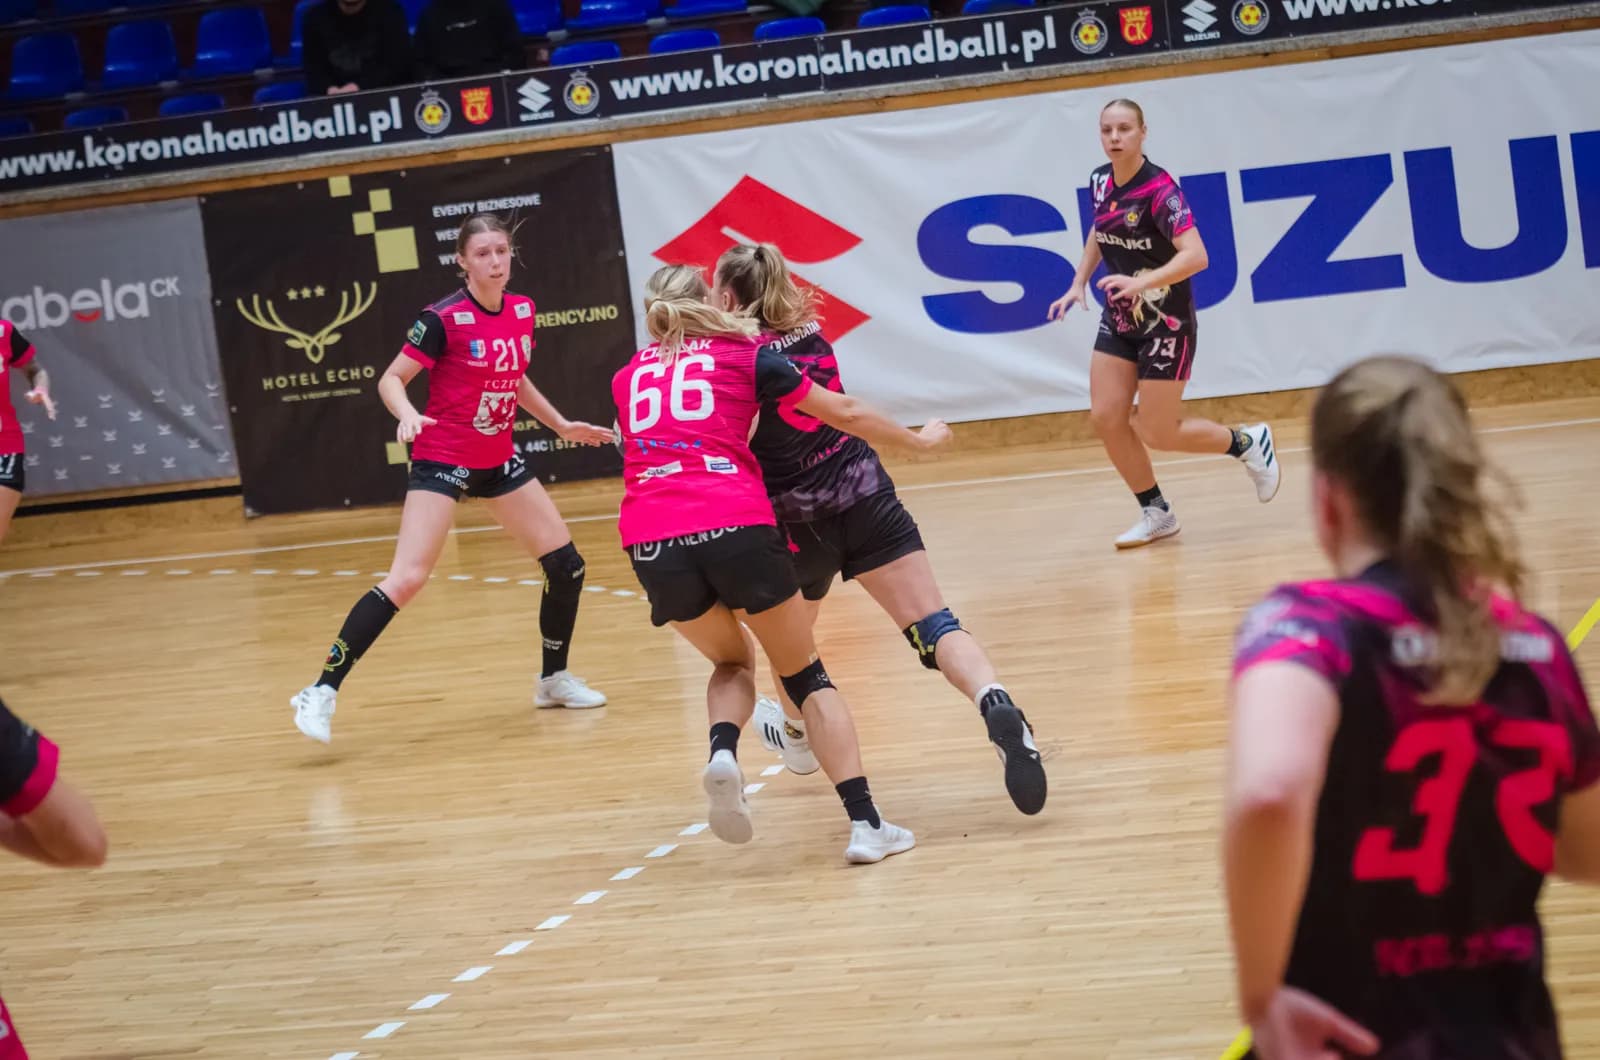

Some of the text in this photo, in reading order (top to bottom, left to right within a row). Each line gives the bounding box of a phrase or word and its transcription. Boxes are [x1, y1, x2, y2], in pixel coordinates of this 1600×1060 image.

[1125, 22, 1147, 42] CK
[1184, 31, 1221, 43] SUZUKI
[610, 16, 1057, 101] www.koronahandball.pl
[0, 97, 402, 180] www.koronahandball.pl
[432, 193, 542, 218] EVENTY BIZNESOWE
[435, 227, 461, 242] WES
[1096, 231, 1153, 250] SUZUKI
[535, 304, 619, 329] RENCYJNO
[492, 337, 520, 373] 21
[262, 365, 376, 390] HOTEL ECHO
[628, 353, 716, 434] 66
[1353, 716, 1574, 895] 32
